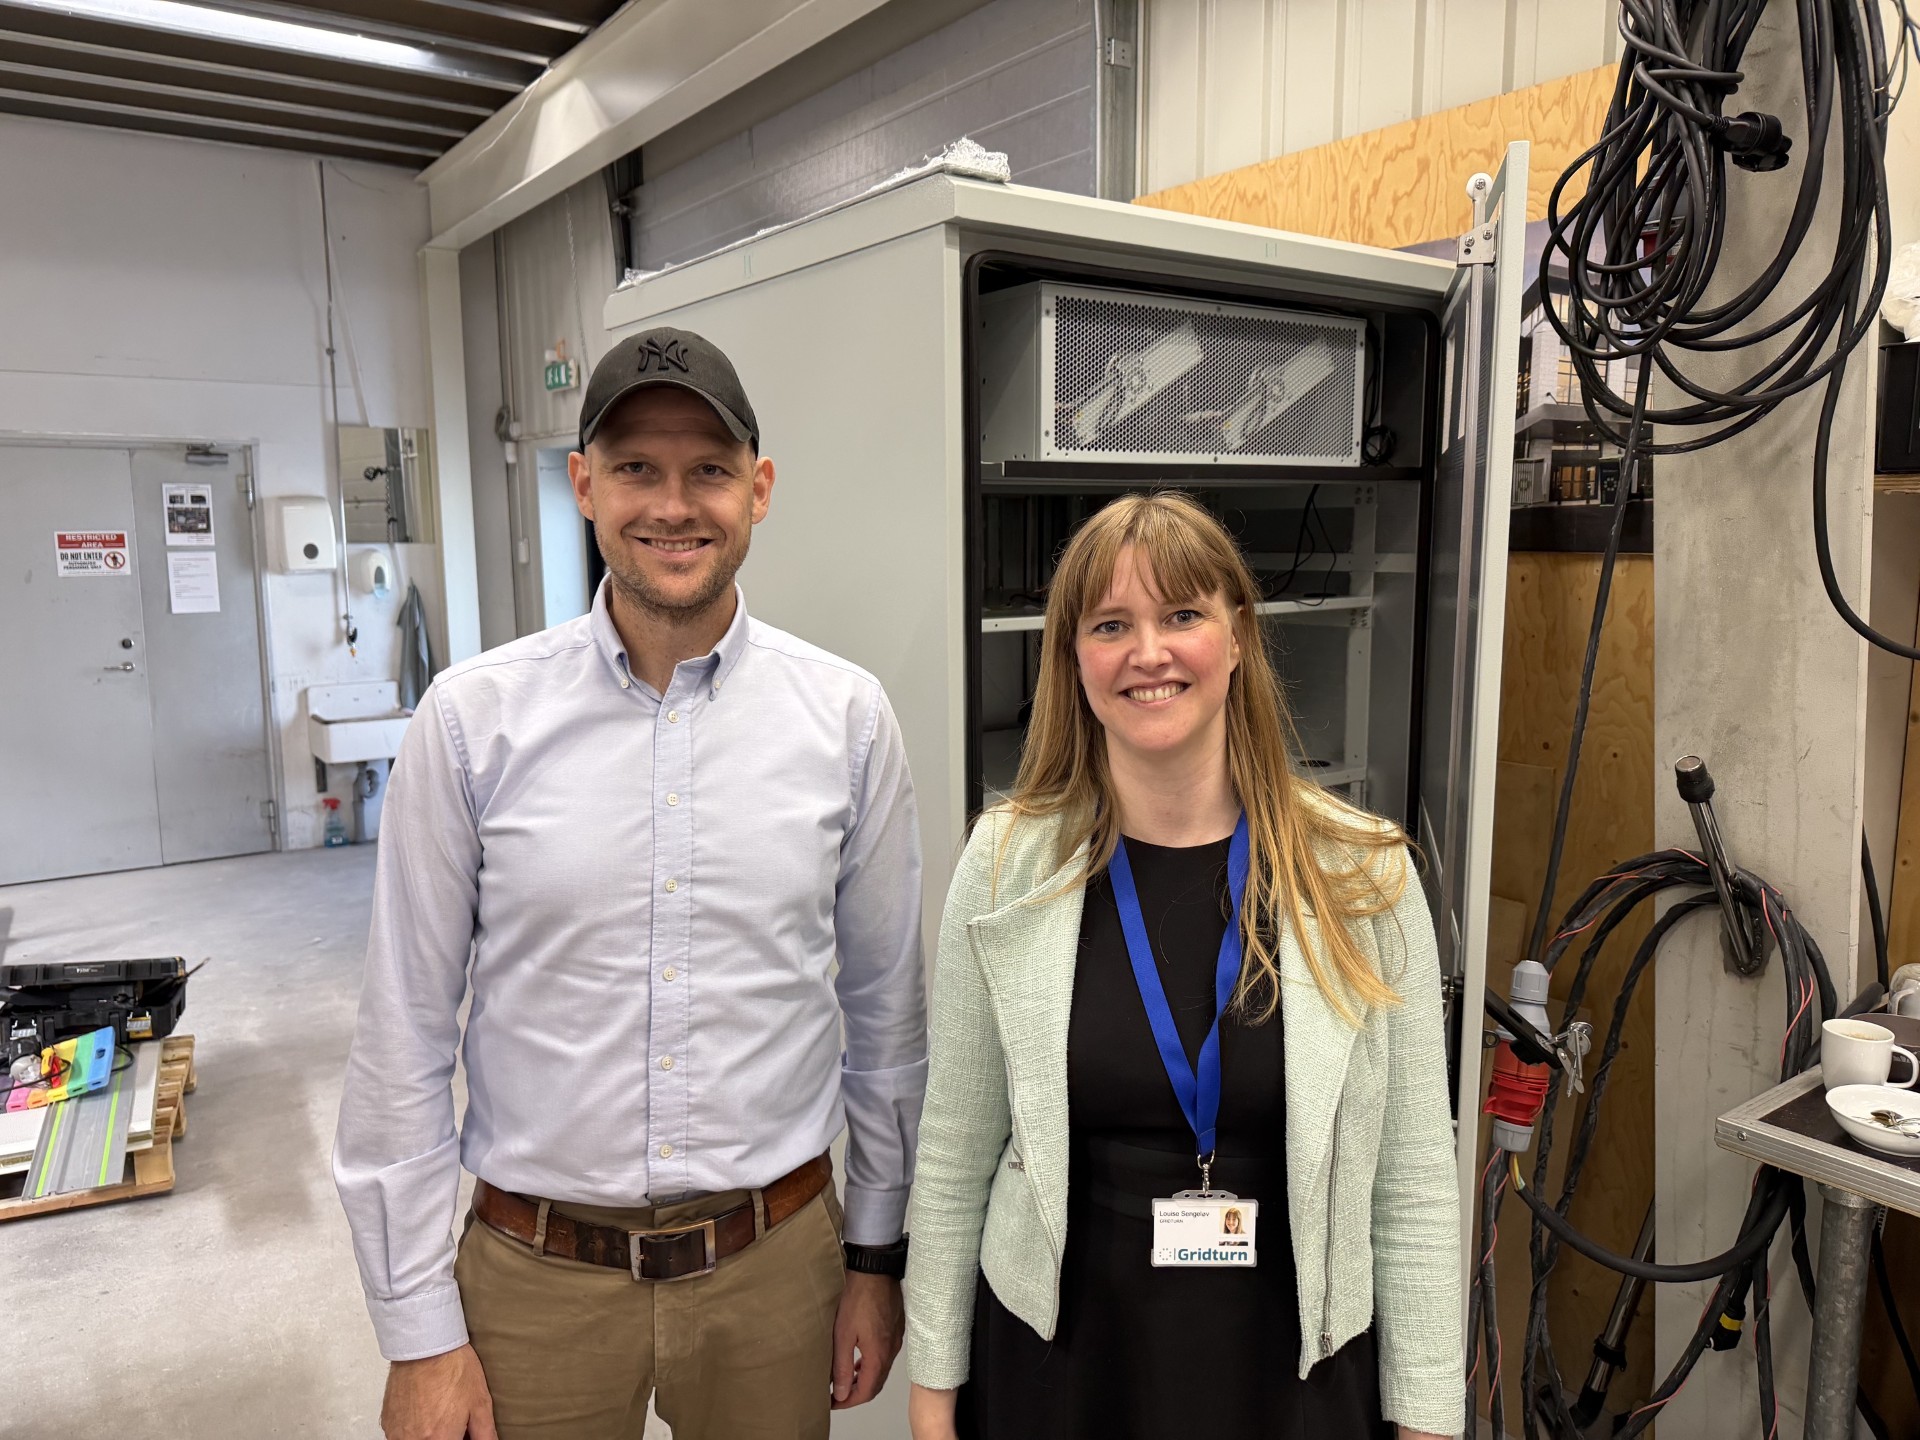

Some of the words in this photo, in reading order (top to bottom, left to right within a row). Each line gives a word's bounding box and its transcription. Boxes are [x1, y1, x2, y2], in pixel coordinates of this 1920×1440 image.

[638, 336, 689, 372] NY
[65, 533, 117, 541] RESTRICTED
[60, 552, 69, 561] DO
[70, 552, 82, 561] NOT
[84, 551, 103, 561] ENTER
[1178, 1248, 1248, 1261] Gridturn
